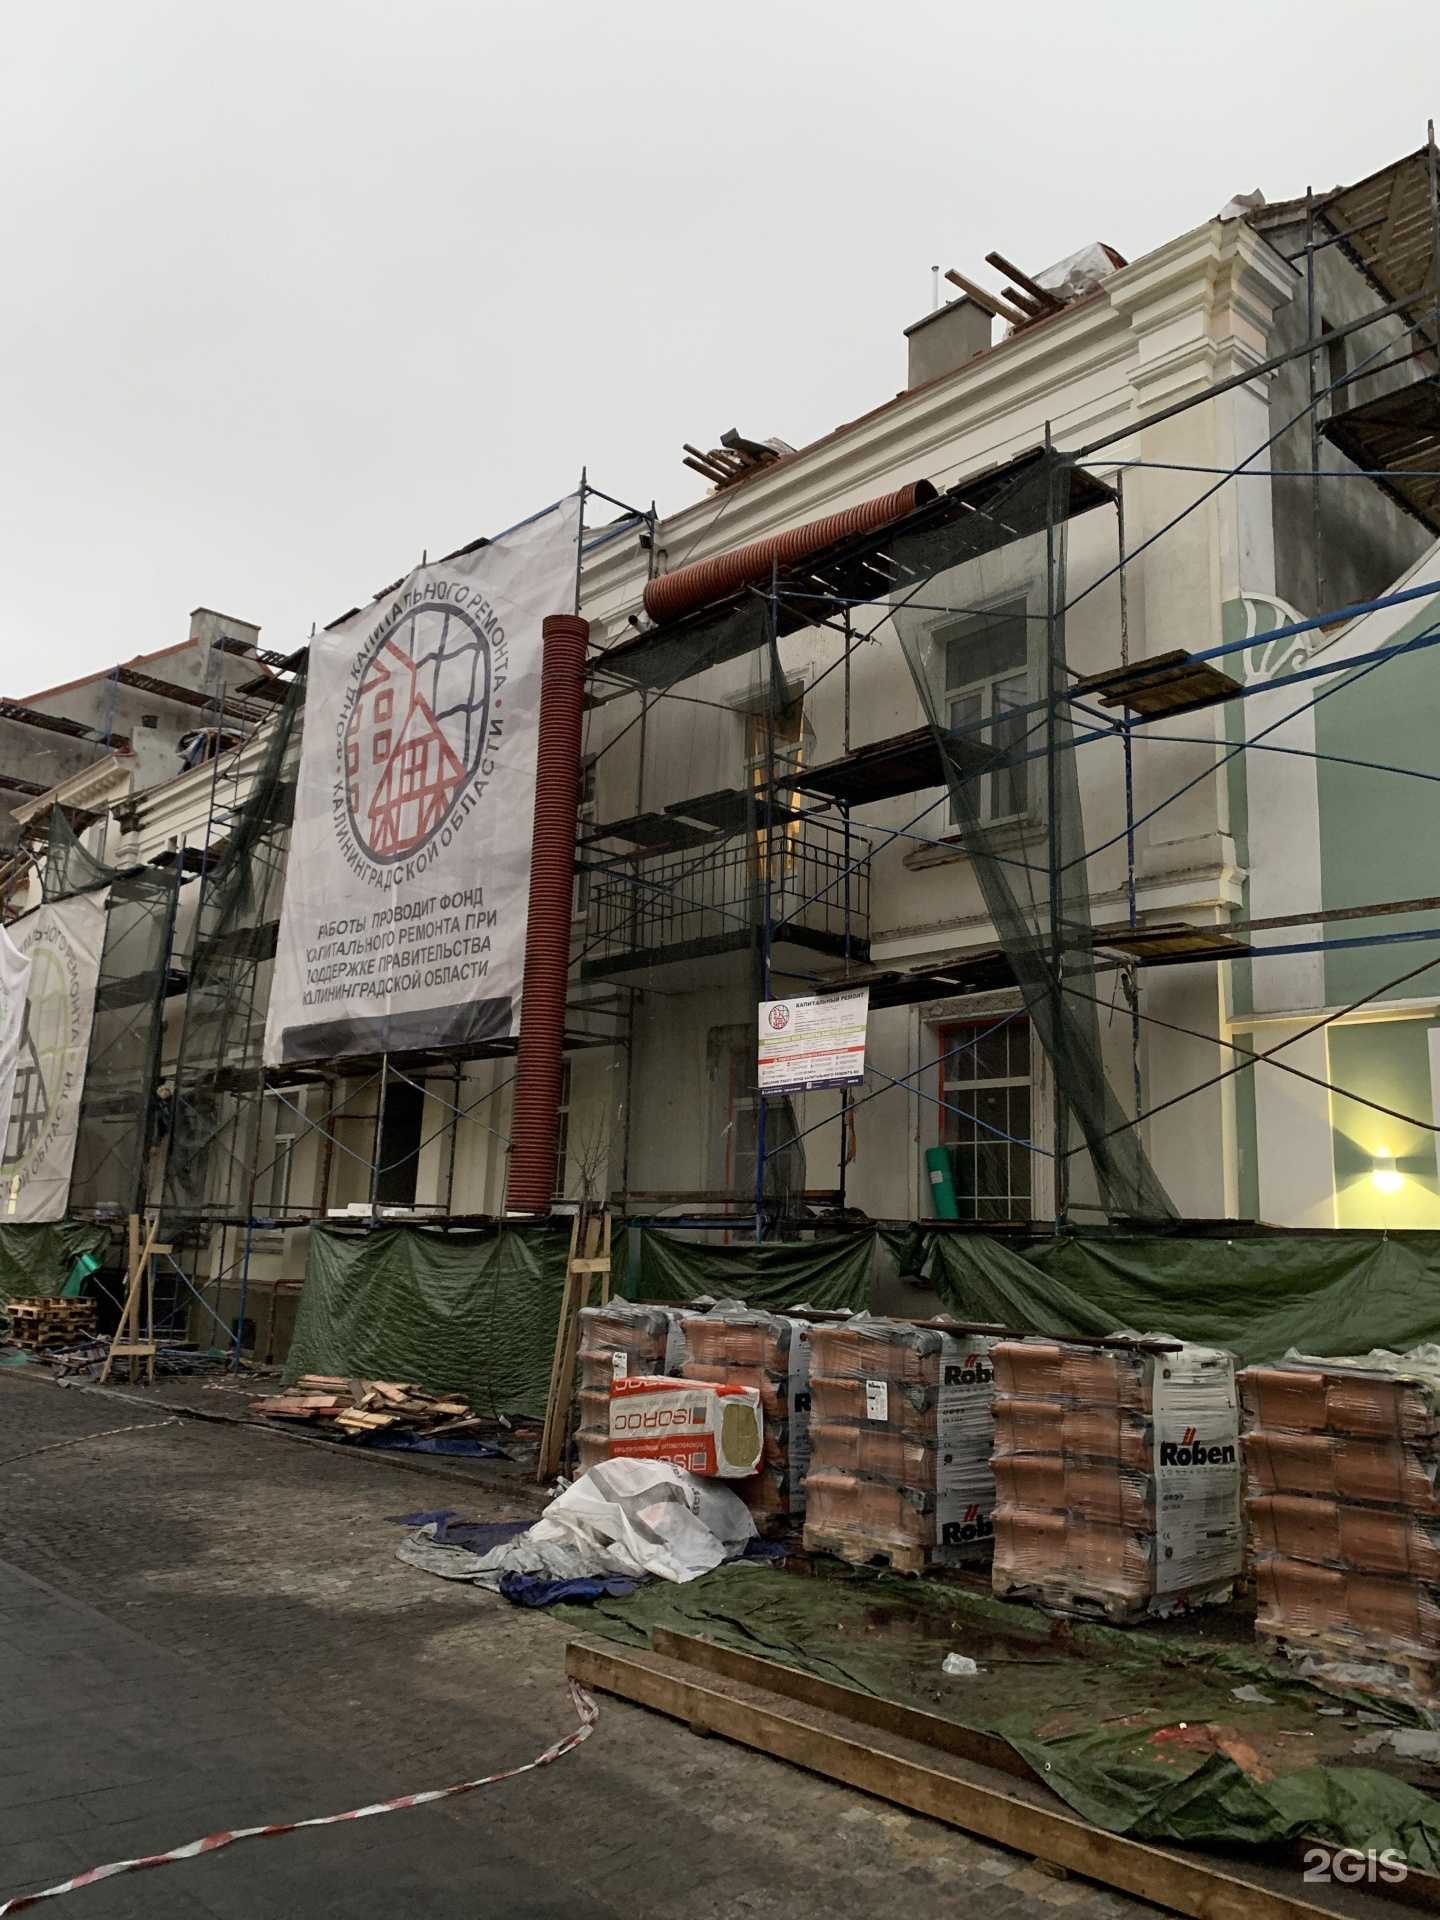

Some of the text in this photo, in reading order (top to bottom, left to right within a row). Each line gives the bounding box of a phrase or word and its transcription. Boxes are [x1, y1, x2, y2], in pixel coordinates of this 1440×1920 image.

[466, 593, 510, 693] РЕМОНТА
[440, 719, 504, 848] ОБЛАСТИ
[317, 887, 483, 941] РАБОТЫ ПРОВОДИТ ФОНД
[398, 916, 461, 945] РЕМОНТА
[464, 909, 498, 931] ПРИ
[377, 935, 492, 972] ПРАВИТЕЛЬСТВА
[424, 959, 490, 988] ОБЛАСТИ
[614, 1407, 692, 1431] ISOROC
[1160, 1427, 1236, 1467] Röben
